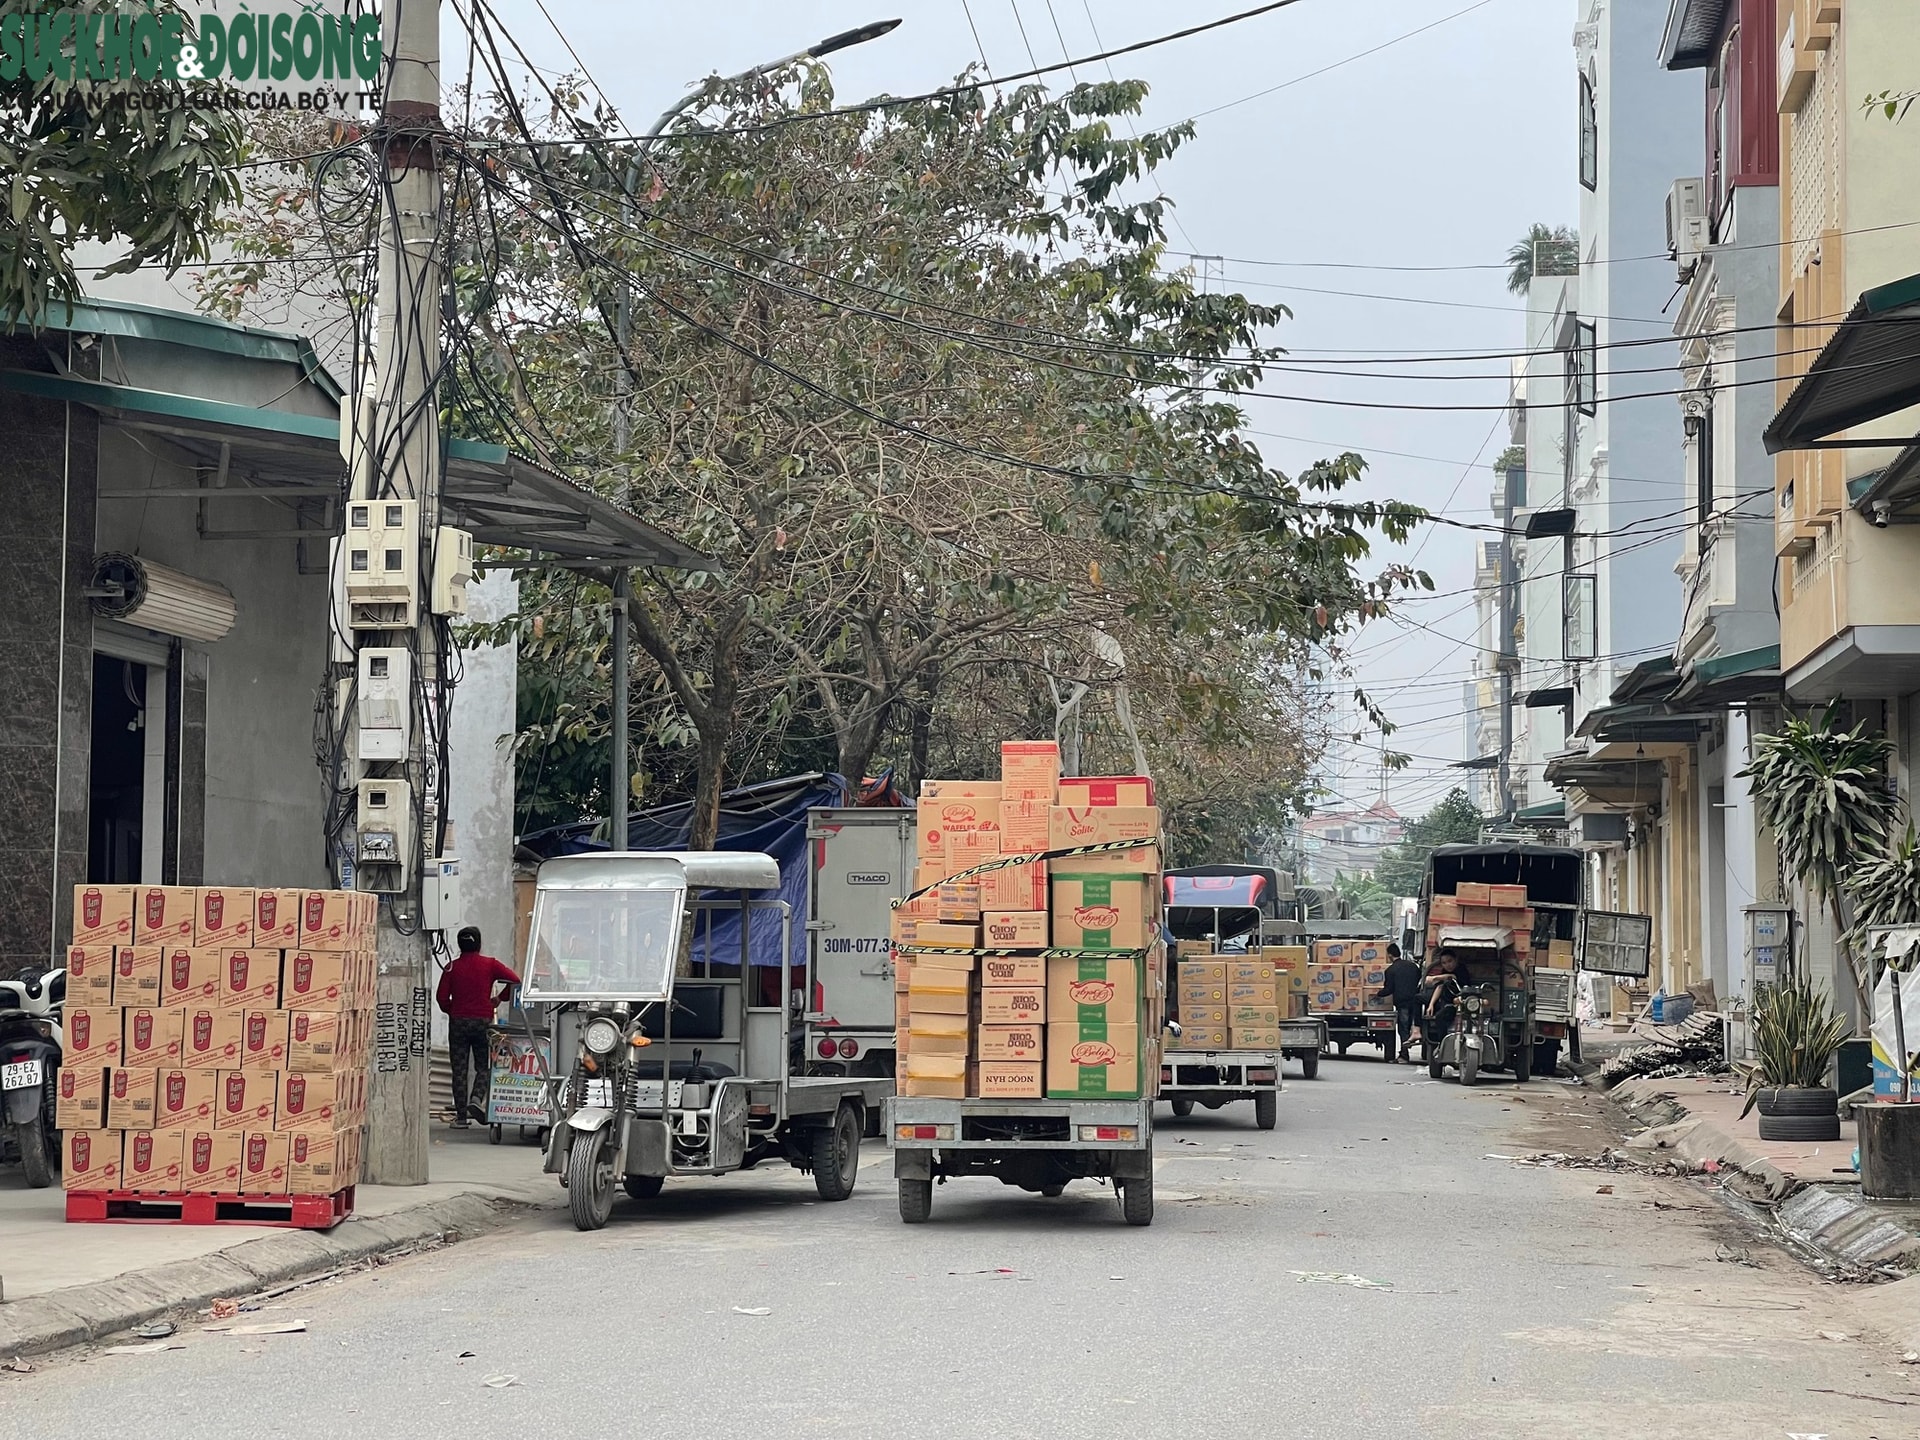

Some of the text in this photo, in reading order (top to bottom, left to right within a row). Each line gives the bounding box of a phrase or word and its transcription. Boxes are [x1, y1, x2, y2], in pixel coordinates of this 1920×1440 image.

[824, 938, 890, 953] 30M-077.3
[907, 946, 1017, 956] SCOTT
[1077, 1044, 1110, 1060] Belgi
[8, 1062, 35, 1075] 29-E2
[5, 1073, 39, 1088] 262.87
